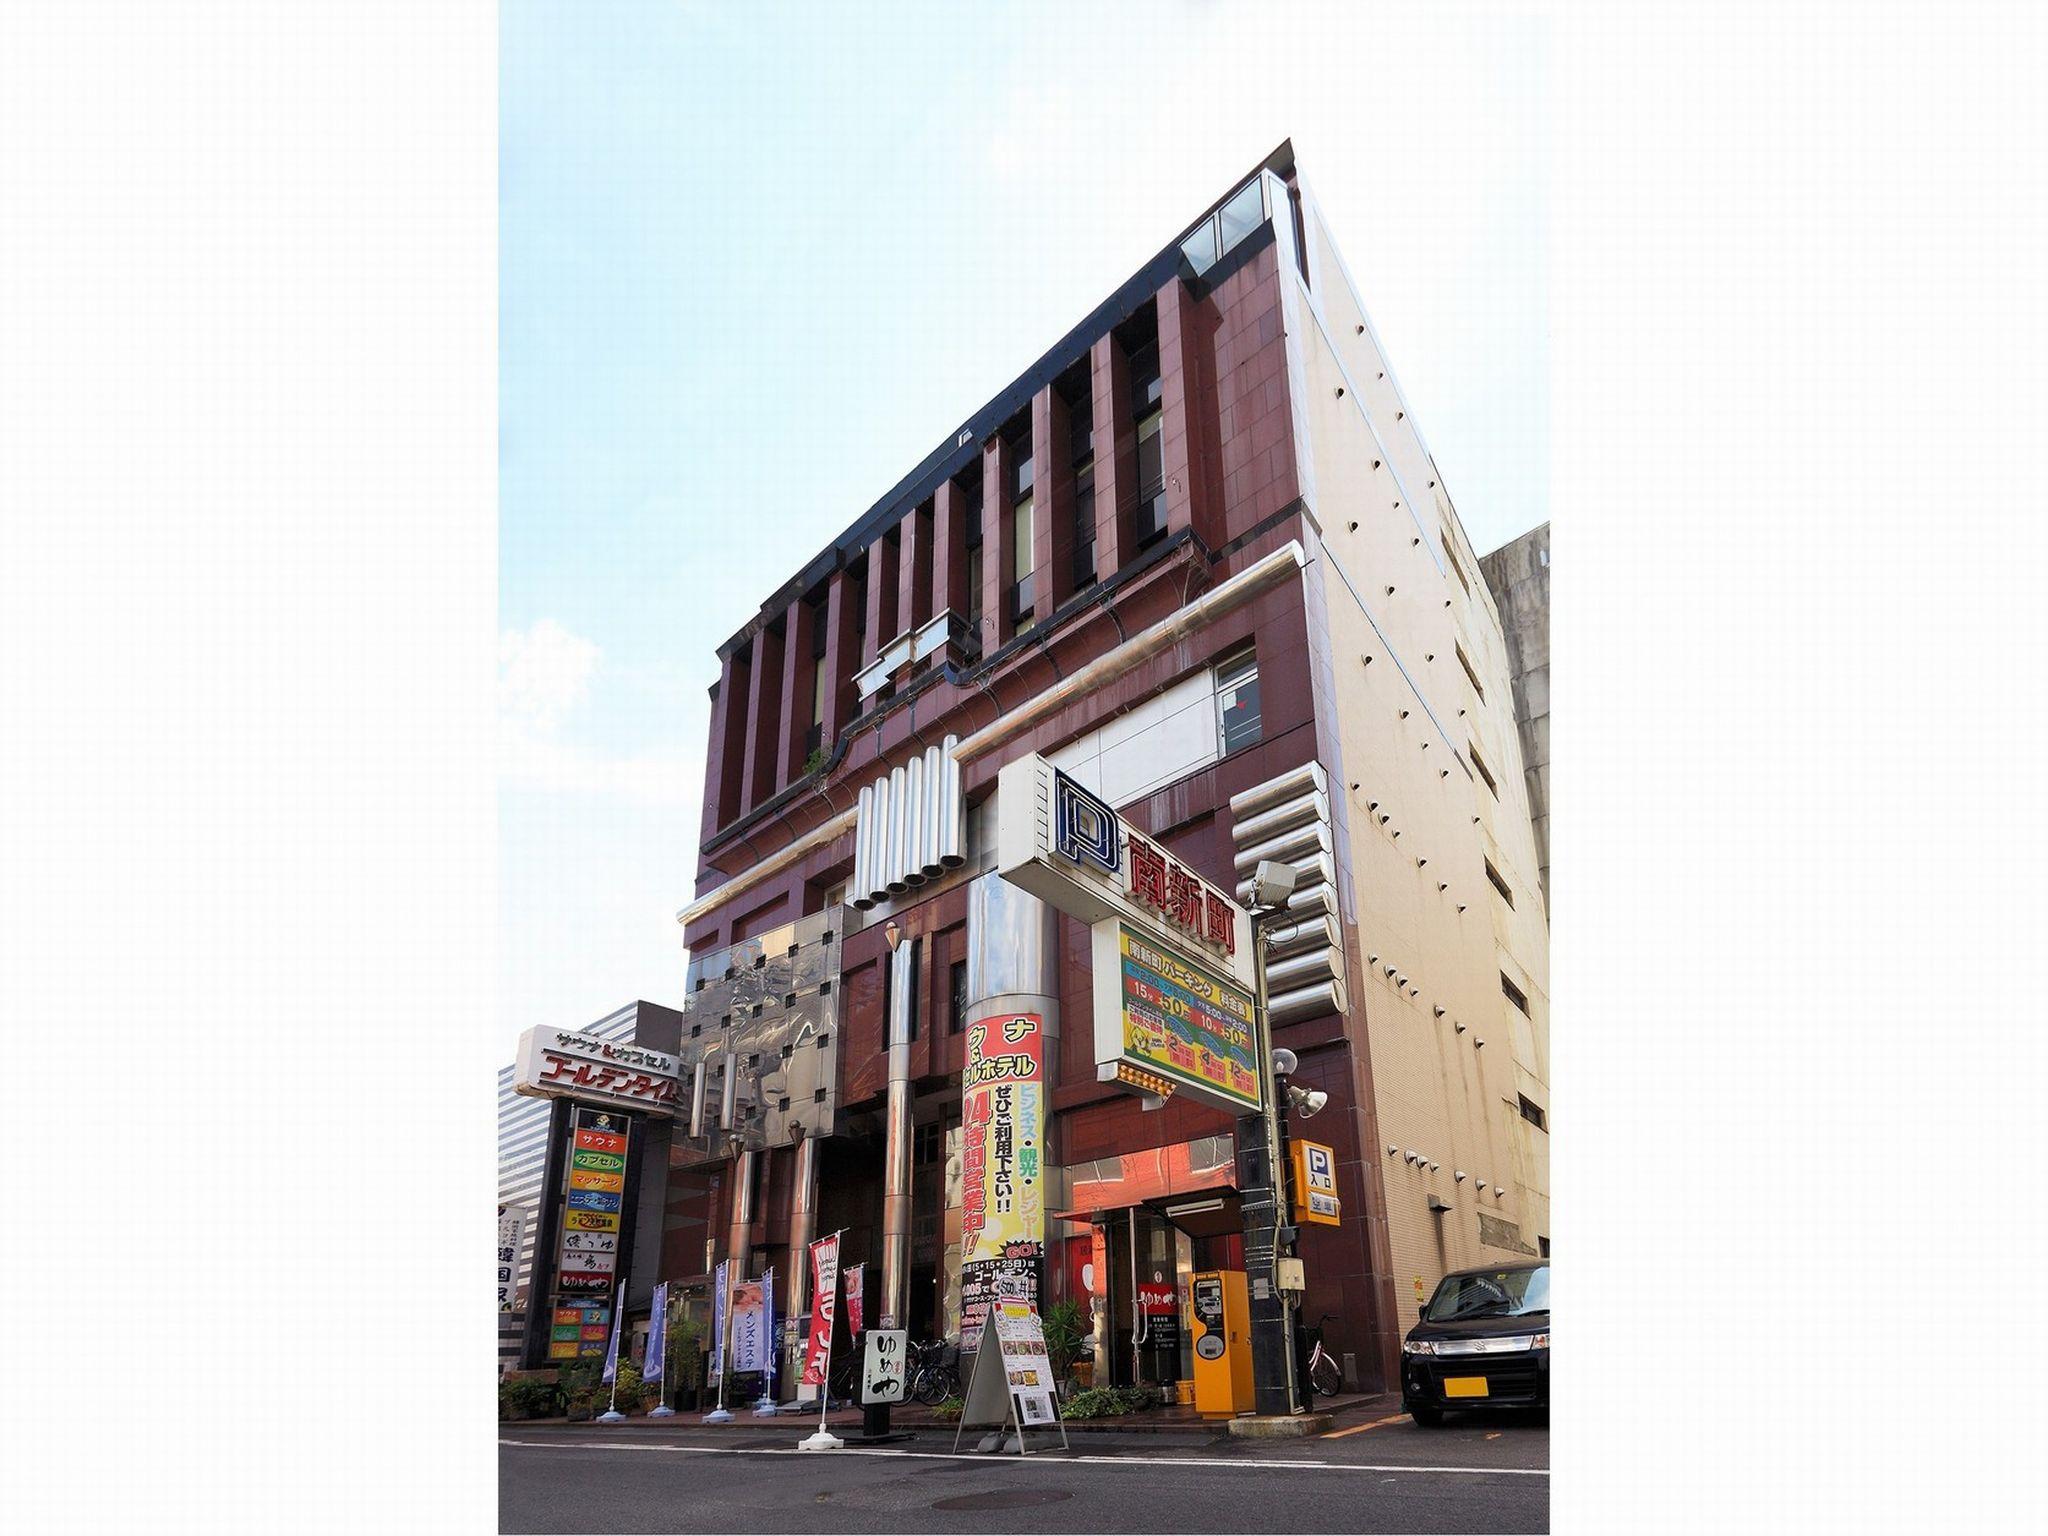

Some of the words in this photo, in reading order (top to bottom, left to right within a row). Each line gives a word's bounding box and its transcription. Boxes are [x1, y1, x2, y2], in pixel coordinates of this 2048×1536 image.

[1056, 770, 1120, 872] P
[1128, 832, 1236, 956] 南新町
[1128, 938, 1163, 973] 南新町
[1163, 959, 1213, 998] パーキング
[540, 1055, 678, 1102] ゴールデンタイム
[583, 1134, 617, 1148] サウナ
[578, 1155, 619, 1167] カプセル
[1311, 1150, 1326, 1172] P
[576, 1175, 618, 1187] マッサージ
[1310, 1174, 1332, 1189] 入口
[745, 1310, 756, 1368] メンズエステ
[871, 1335, 900, 1398] ゆめや
